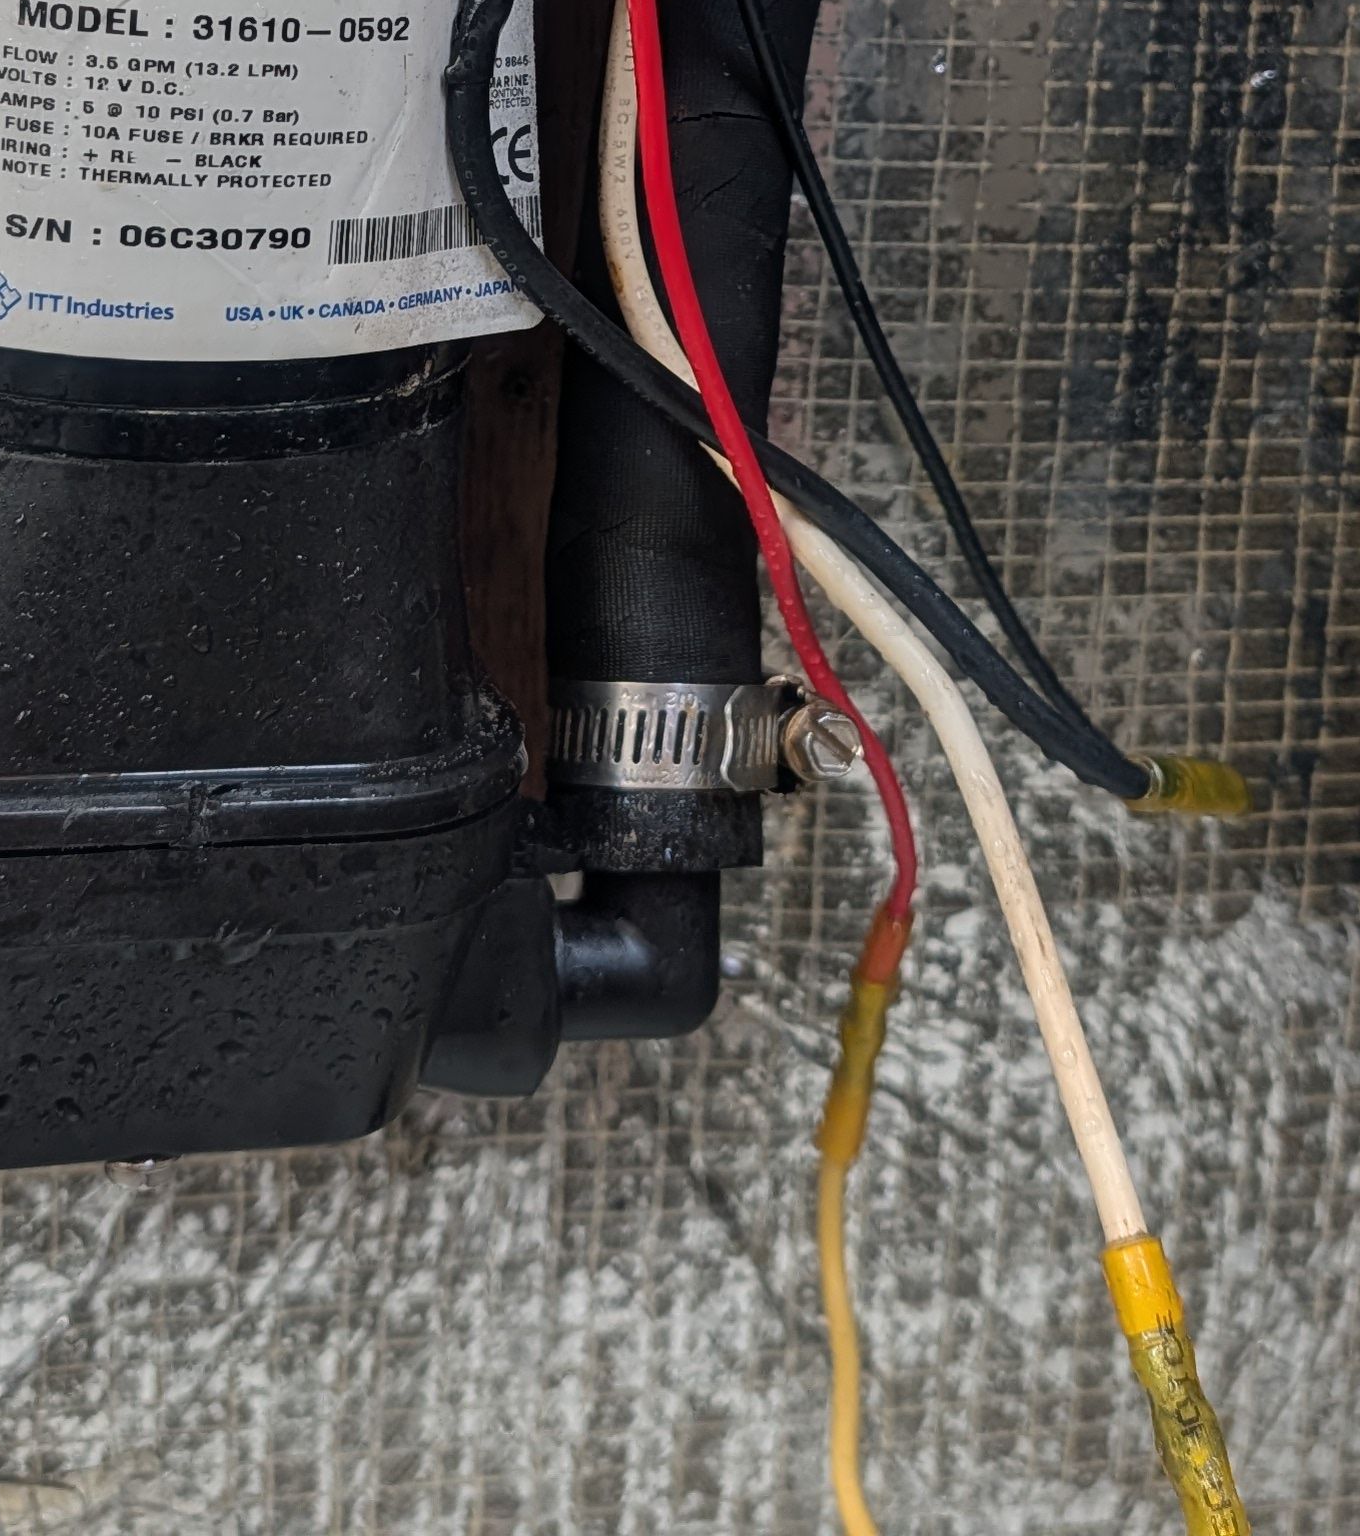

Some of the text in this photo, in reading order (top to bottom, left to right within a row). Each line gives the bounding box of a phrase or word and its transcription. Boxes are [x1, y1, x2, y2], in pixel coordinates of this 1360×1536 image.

[2, 45, 58, 65] FLOW
[85, 54, 120, 71] 3.5
[127, 57, 176, 75] GPM
[184, 61, 240, 79] (13.2
[247, 63, 300, 80] LPM)
[84, 76, 110, 91] 12
[117, 78, 133, 93] V
[141, 80, 185, 97] D.C.
[0, 91, 56, 111] AMPS
[106, 102, 123, 118] @
[135, 104, 161, 120] 10
[170, 106, 204, 122] PSI
[212, 108, 254, 126] (0.7
[262, 109, 300, 126] Bar)
[488, 96, 532, 110] ROTECTED
[4, 115, 55, 135] FUSE
[81, 124, 121, 142] 10A
[128, 127, 184, 145] FUSE
[209, 131, 265, 147] BRKR
[272, 130, 369, 147] REQUIRED
[1, 158, 52, 179] NOTE
[79, 166, 209, 188] THERMALLY
[216, 172, 333, 189] PROTECTED
[110, 149, 138, 165] RE
[194, 154, 264, 169] BLACK
[4, 213, 73, 244] S/N
[118, 224, 312, 251] 06C30790
[615, 207, 637, 260] 600V
[27, 291, 175, 321] ITT Industries
[225, 306, 264, 322] USA
[279, 305, 304, 320] UK
[318, 298, 386, 319] CANADA
[397, 285, 464, 311] GERMANY
